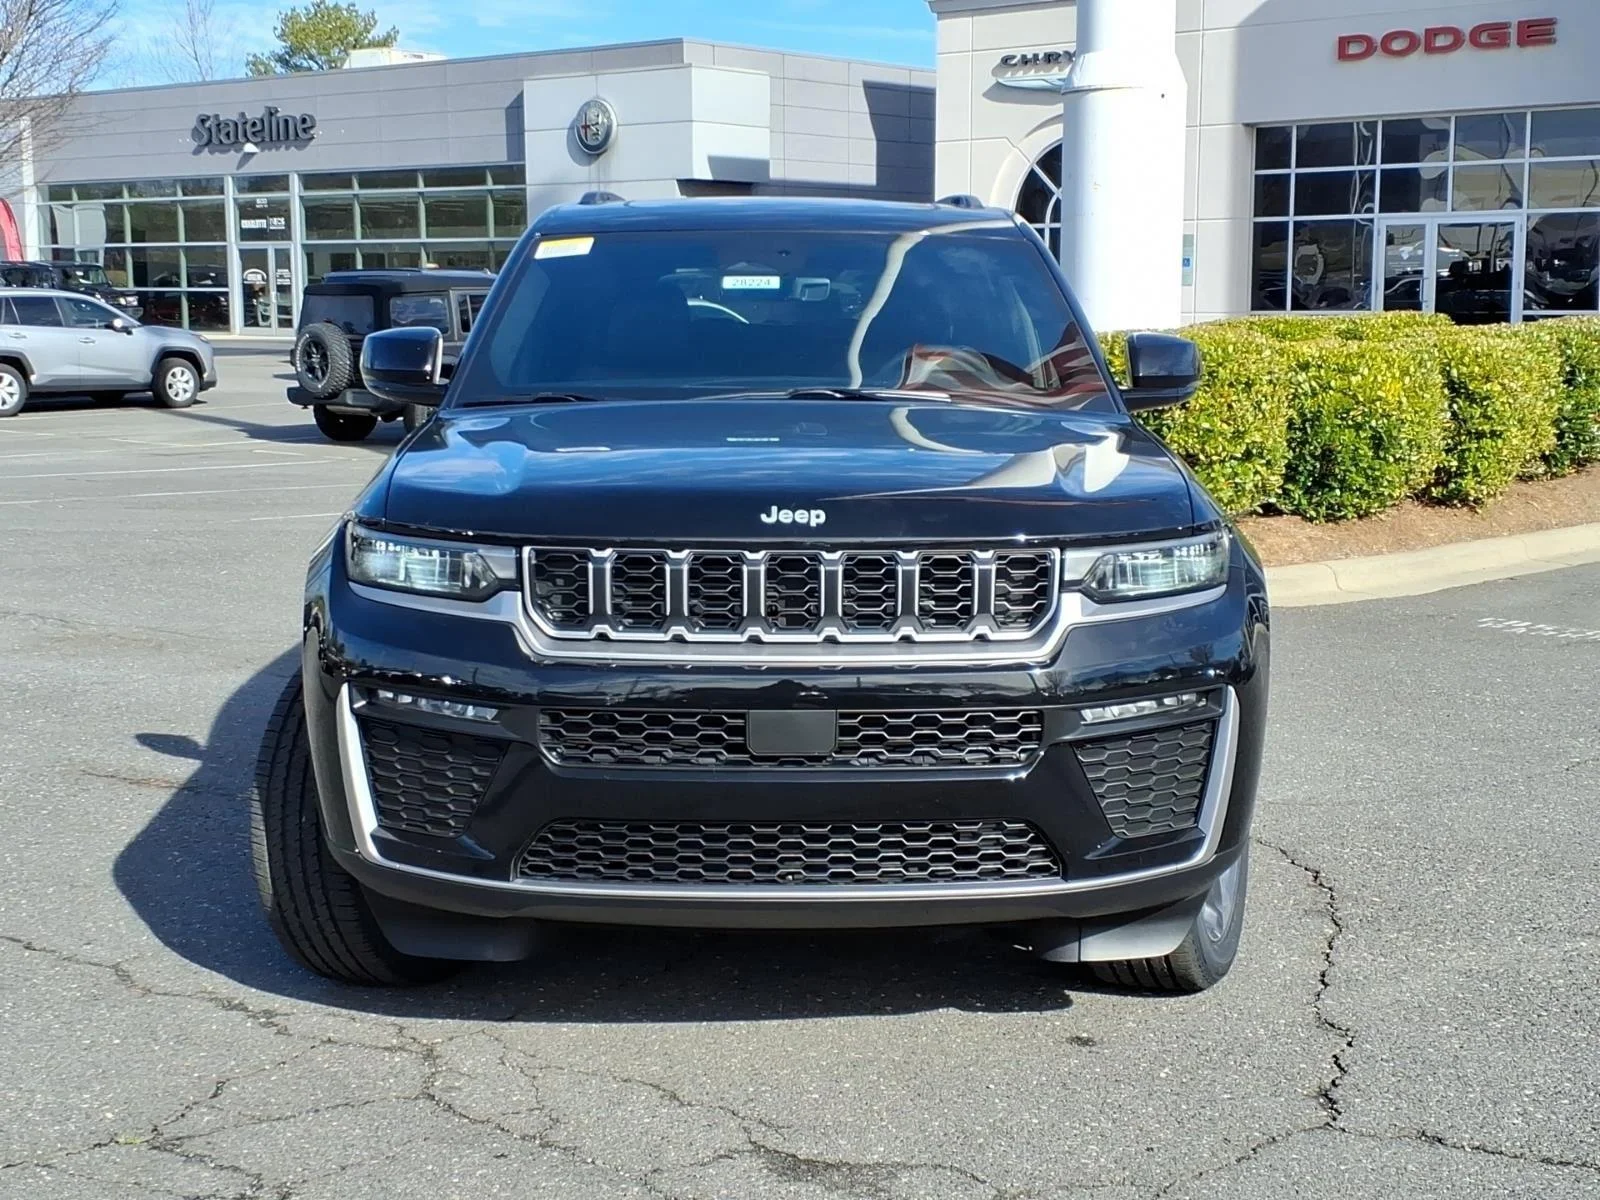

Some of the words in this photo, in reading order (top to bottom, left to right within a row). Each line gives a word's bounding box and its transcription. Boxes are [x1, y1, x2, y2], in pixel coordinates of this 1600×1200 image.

[1337, 17, 1557, 61] DODGE
[1000, 50, 1076, 66] CHRY
[192, 106, 317, 146] Stateline
[760, 505, 826, 527] Jeep
